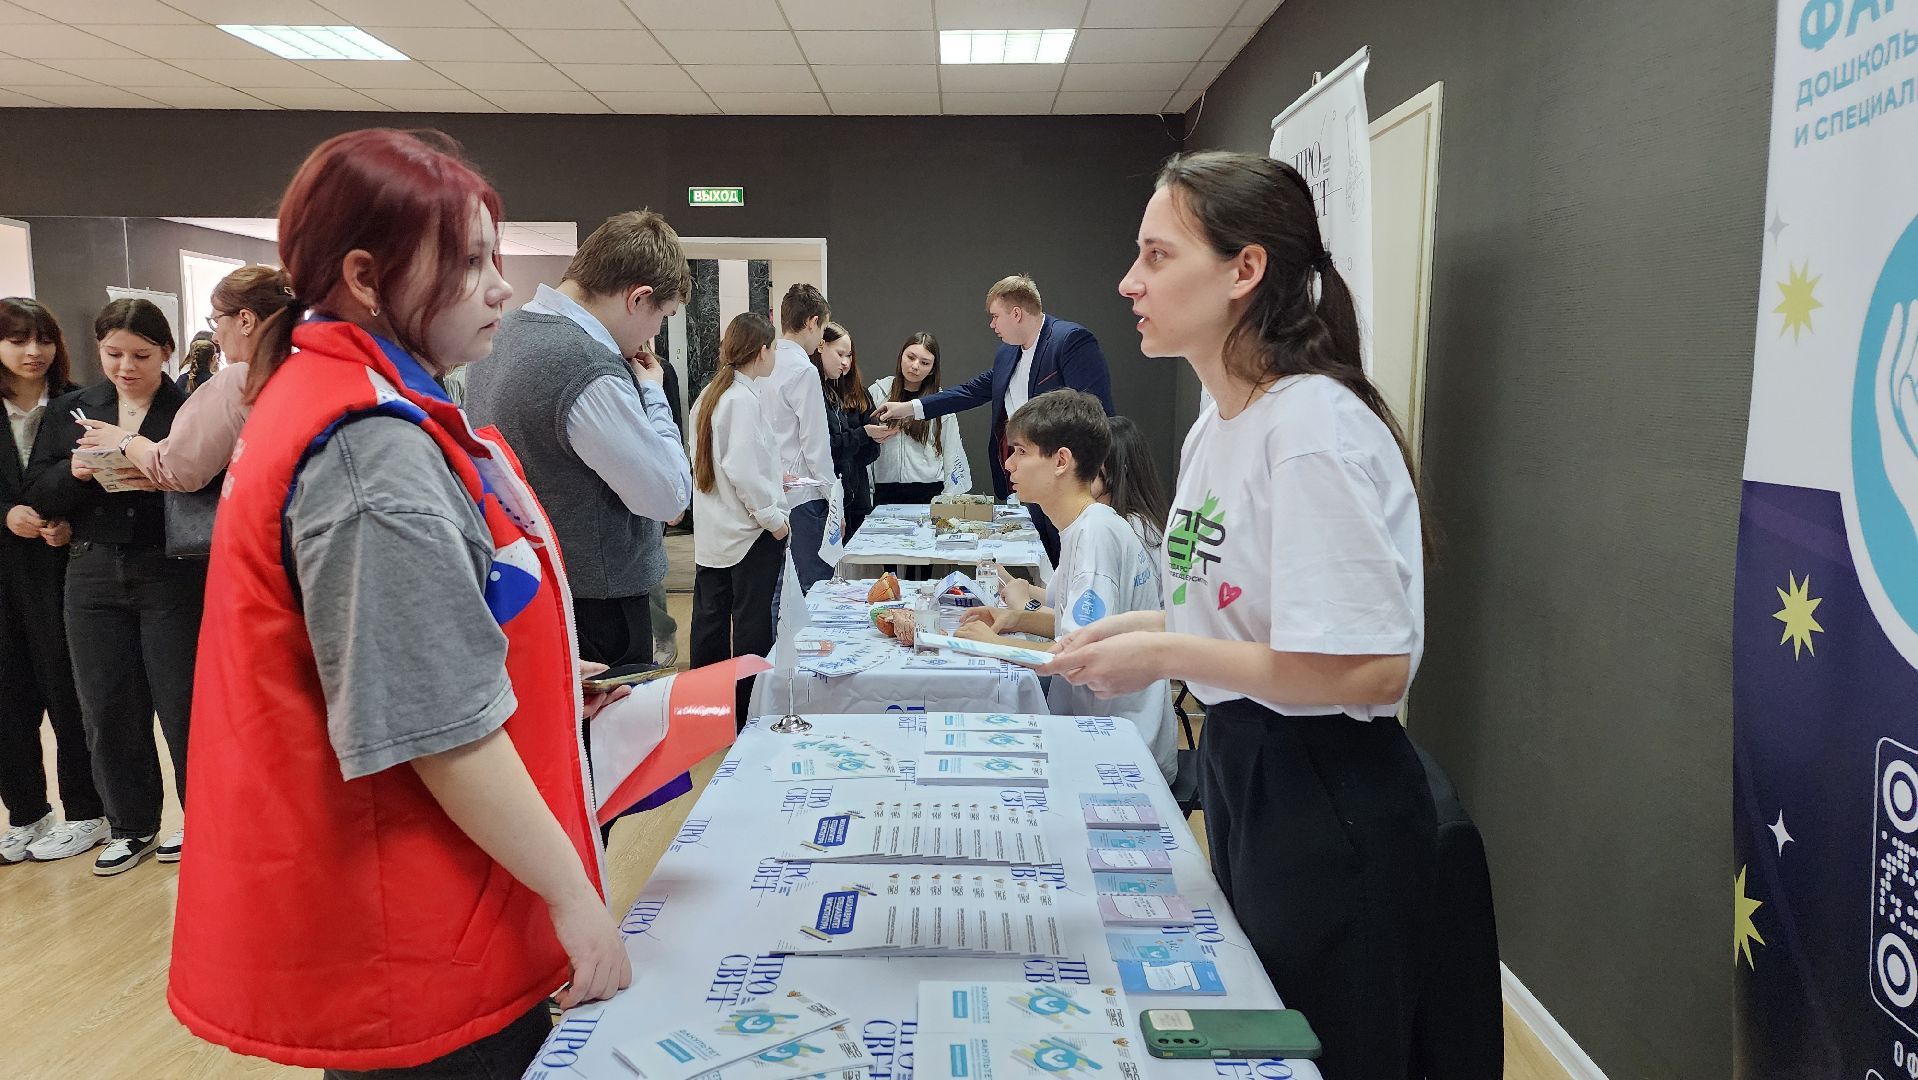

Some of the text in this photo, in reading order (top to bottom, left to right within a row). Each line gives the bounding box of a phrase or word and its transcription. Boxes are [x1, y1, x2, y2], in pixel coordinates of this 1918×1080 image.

[1800, 0, 1894, 52] ФА
[1794, 78, 1915, 149] И СПЕЦИАЛ
[693, 189, 738, 202] ВЫХОД
[807, 786, 833, 808] ПРО
[676, 817, 711, 843] ПРО
[622, 897, 666, 934] ПРО
[1191, 905, 1225, 943] ПРО
[705, 954, 751, 1008] СВЕТ
[745, 954, 785, 994] ПРО
[541, 1015, 601, 1067] ПРО
